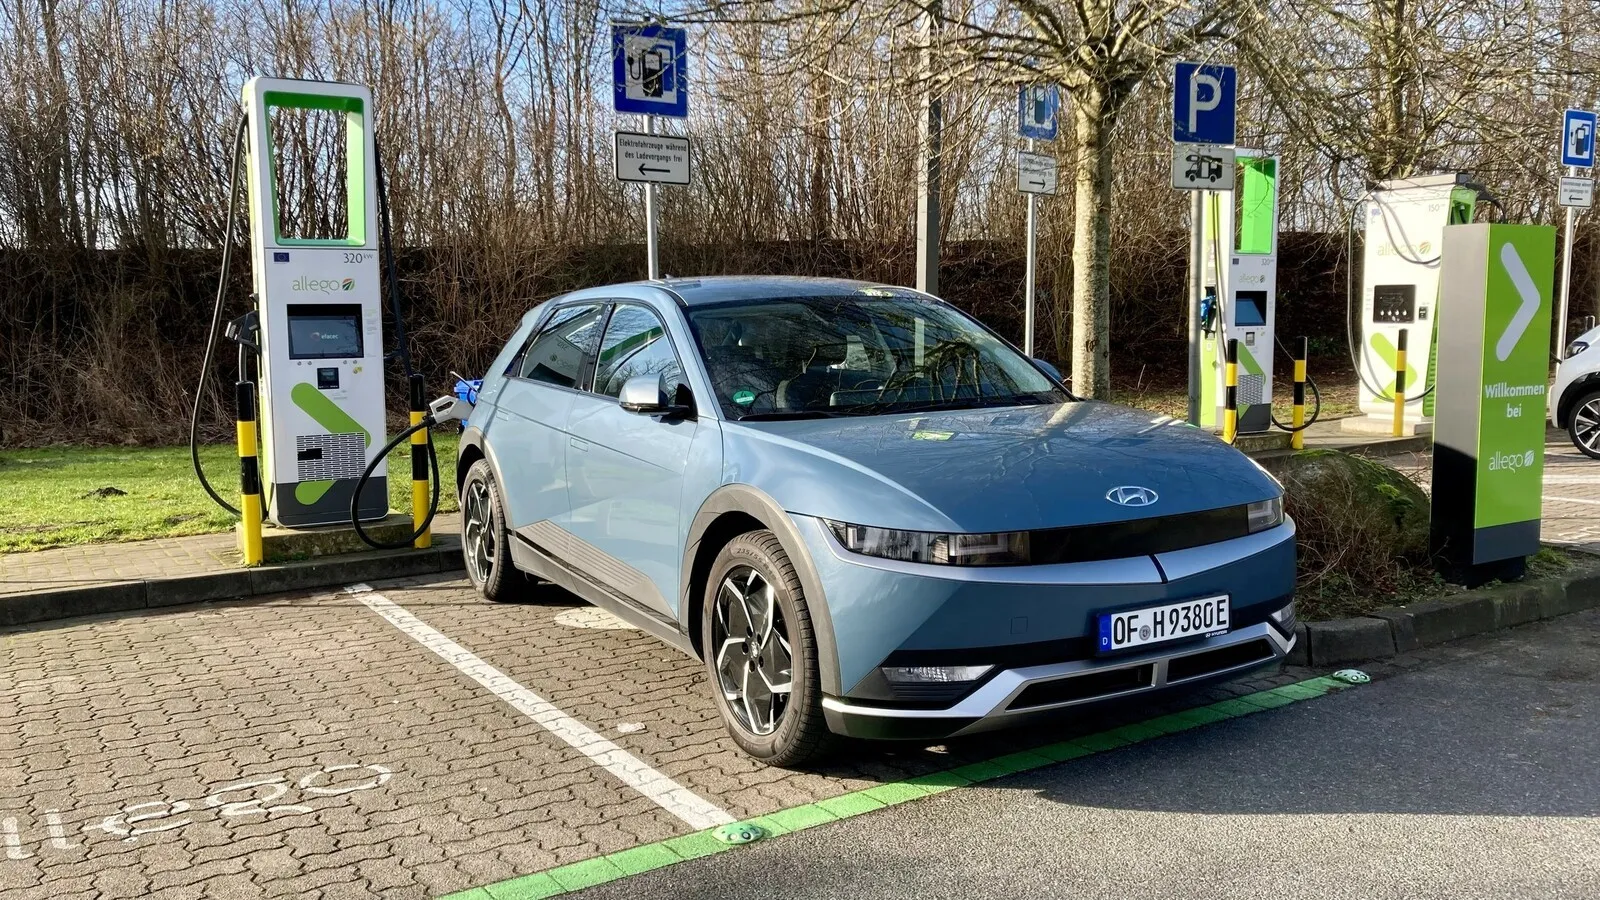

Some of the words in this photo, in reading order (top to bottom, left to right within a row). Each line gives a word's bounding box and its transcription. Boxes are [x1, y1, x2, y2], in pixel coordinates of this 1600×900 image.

[1189, 74, 1222, 133] P
[620, 139, 663, 151] Elektrofahrzeuge
[666, 143, 686, 151] während
[625, 151, 634, 159] des
[636, 151, 672, 163] Ladevorgangs
[674, 154, 682, 162] frei
[1428, 204, 1441, 212] 150
[343, 253, 363, 264] 320
[292, 276, 340, 295] allego
[1485, 382, 1545, 399] Willkommen
[1506, 403, 1522, 418] bei
[1488, 451, 1524, 473] allego
[1102, 637, 1108, 646] D
